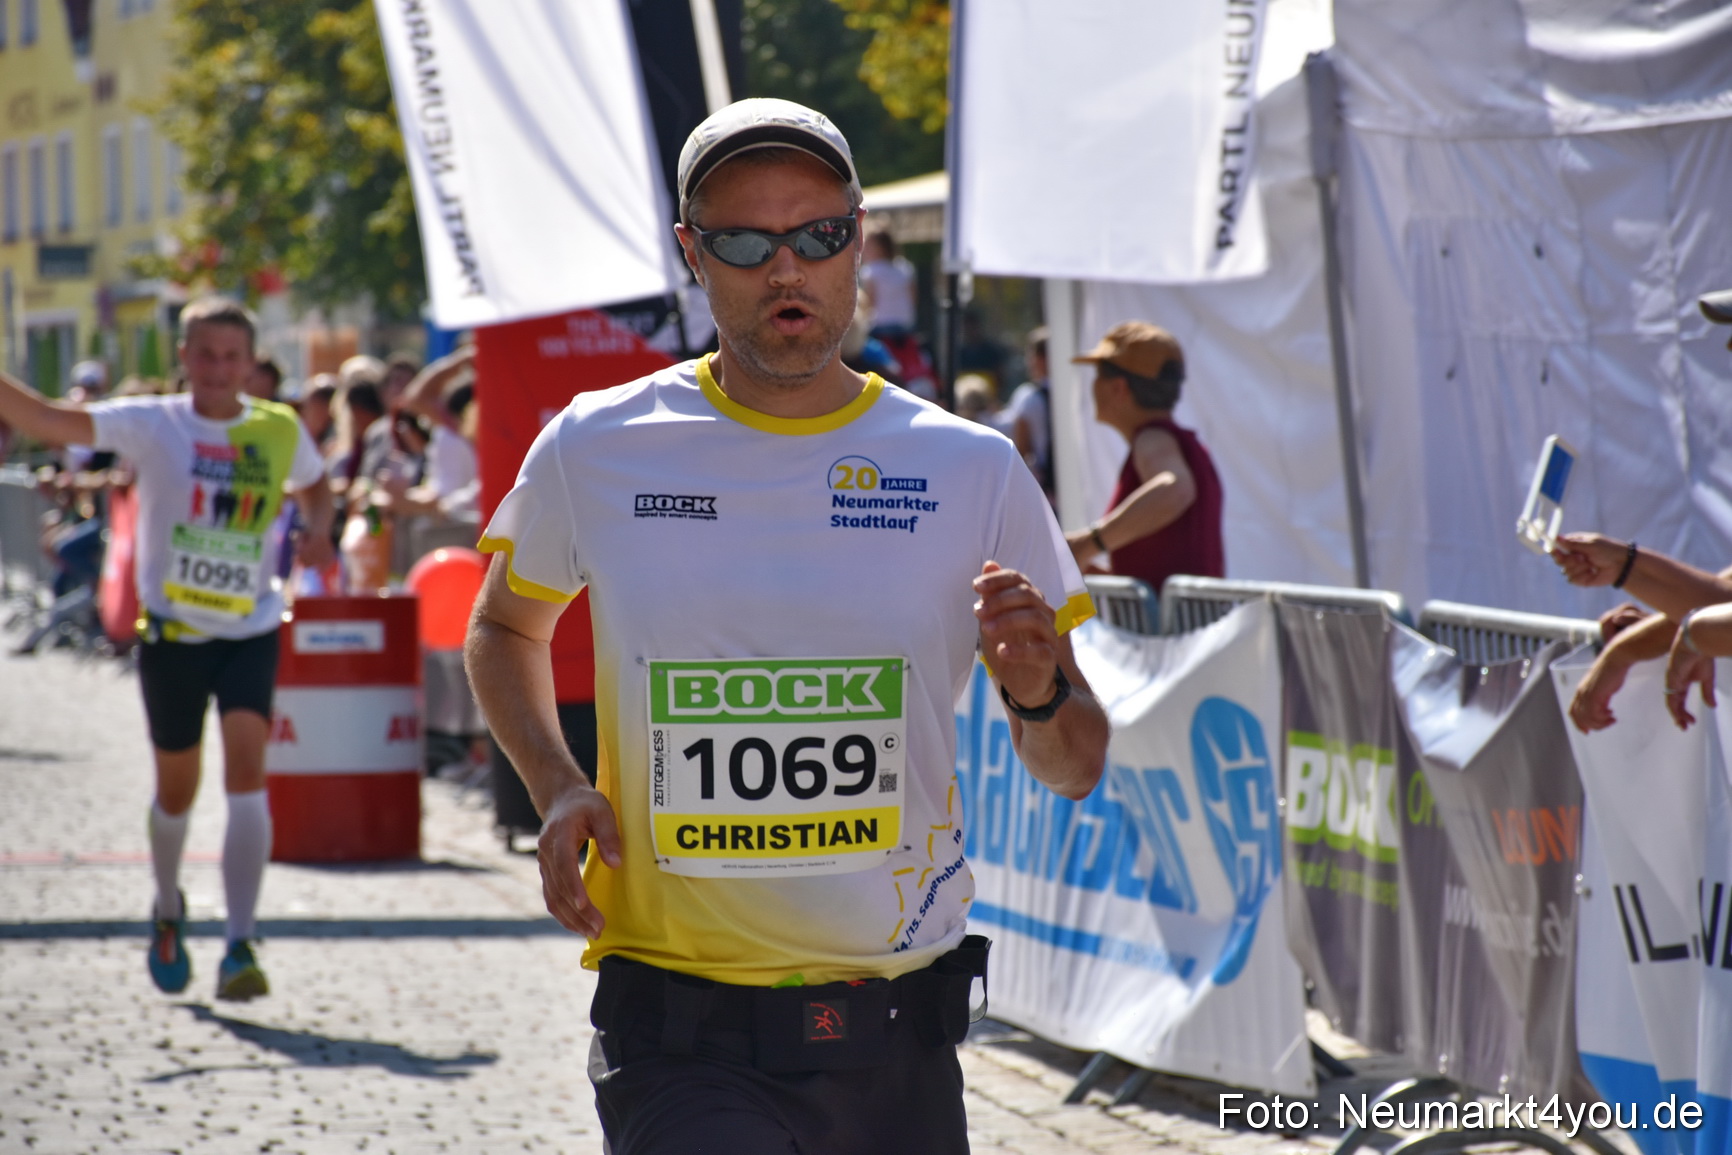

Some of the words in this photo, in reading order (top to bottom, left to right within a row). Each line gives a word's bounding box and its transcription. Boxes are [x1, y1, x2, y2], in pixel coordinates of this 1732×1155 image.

[1223, 0, 1258, 98] NEU
[1216, 110, 1250, 250] PARTL
[834, 465, 878, 491] 20
[885, 480, 923, 490] JAHRE
[635, 494, 717, 514] BOCK
[832, 494, 939, 512] Neumarkter
[830, 514, 919, 534] Stadtlauf
[178, 555, 250, 592] 1099
[667, 666, 887, 716] BOCK
[682, 734, 877, 801] 1069
[676, 818, 878, 850] CHRISTIAN
